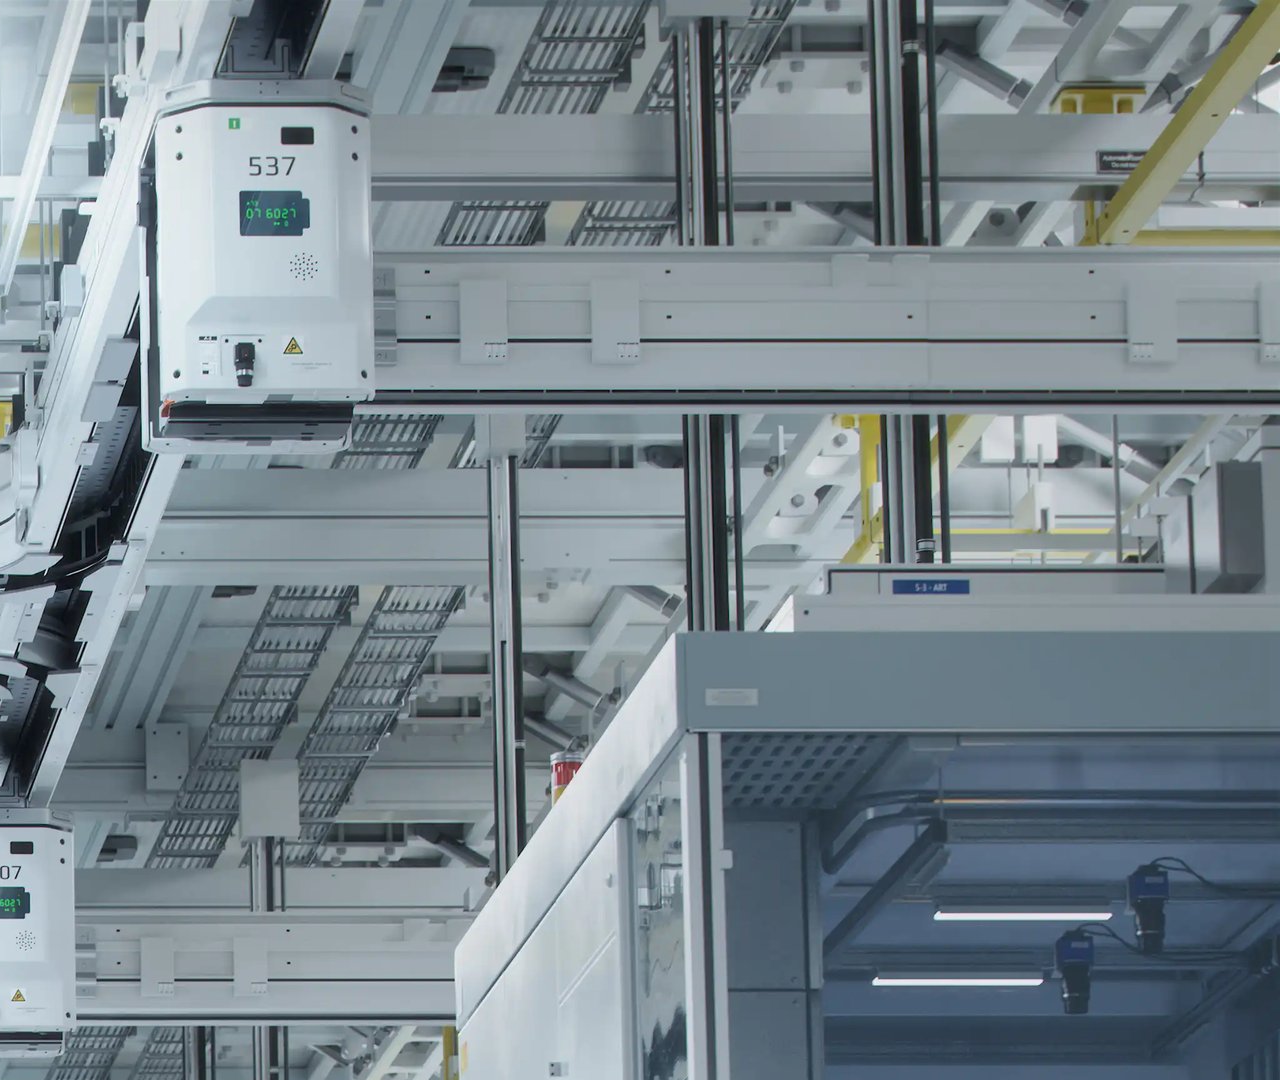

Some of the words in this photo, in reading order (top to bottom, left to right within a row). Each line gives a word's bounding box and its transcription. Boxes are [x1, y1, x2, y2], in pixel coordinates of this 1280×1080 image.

[249, 156, 296, 176] 537
[246, 207, 261, 219] 07
[266, 207, 296, 219] 6027
